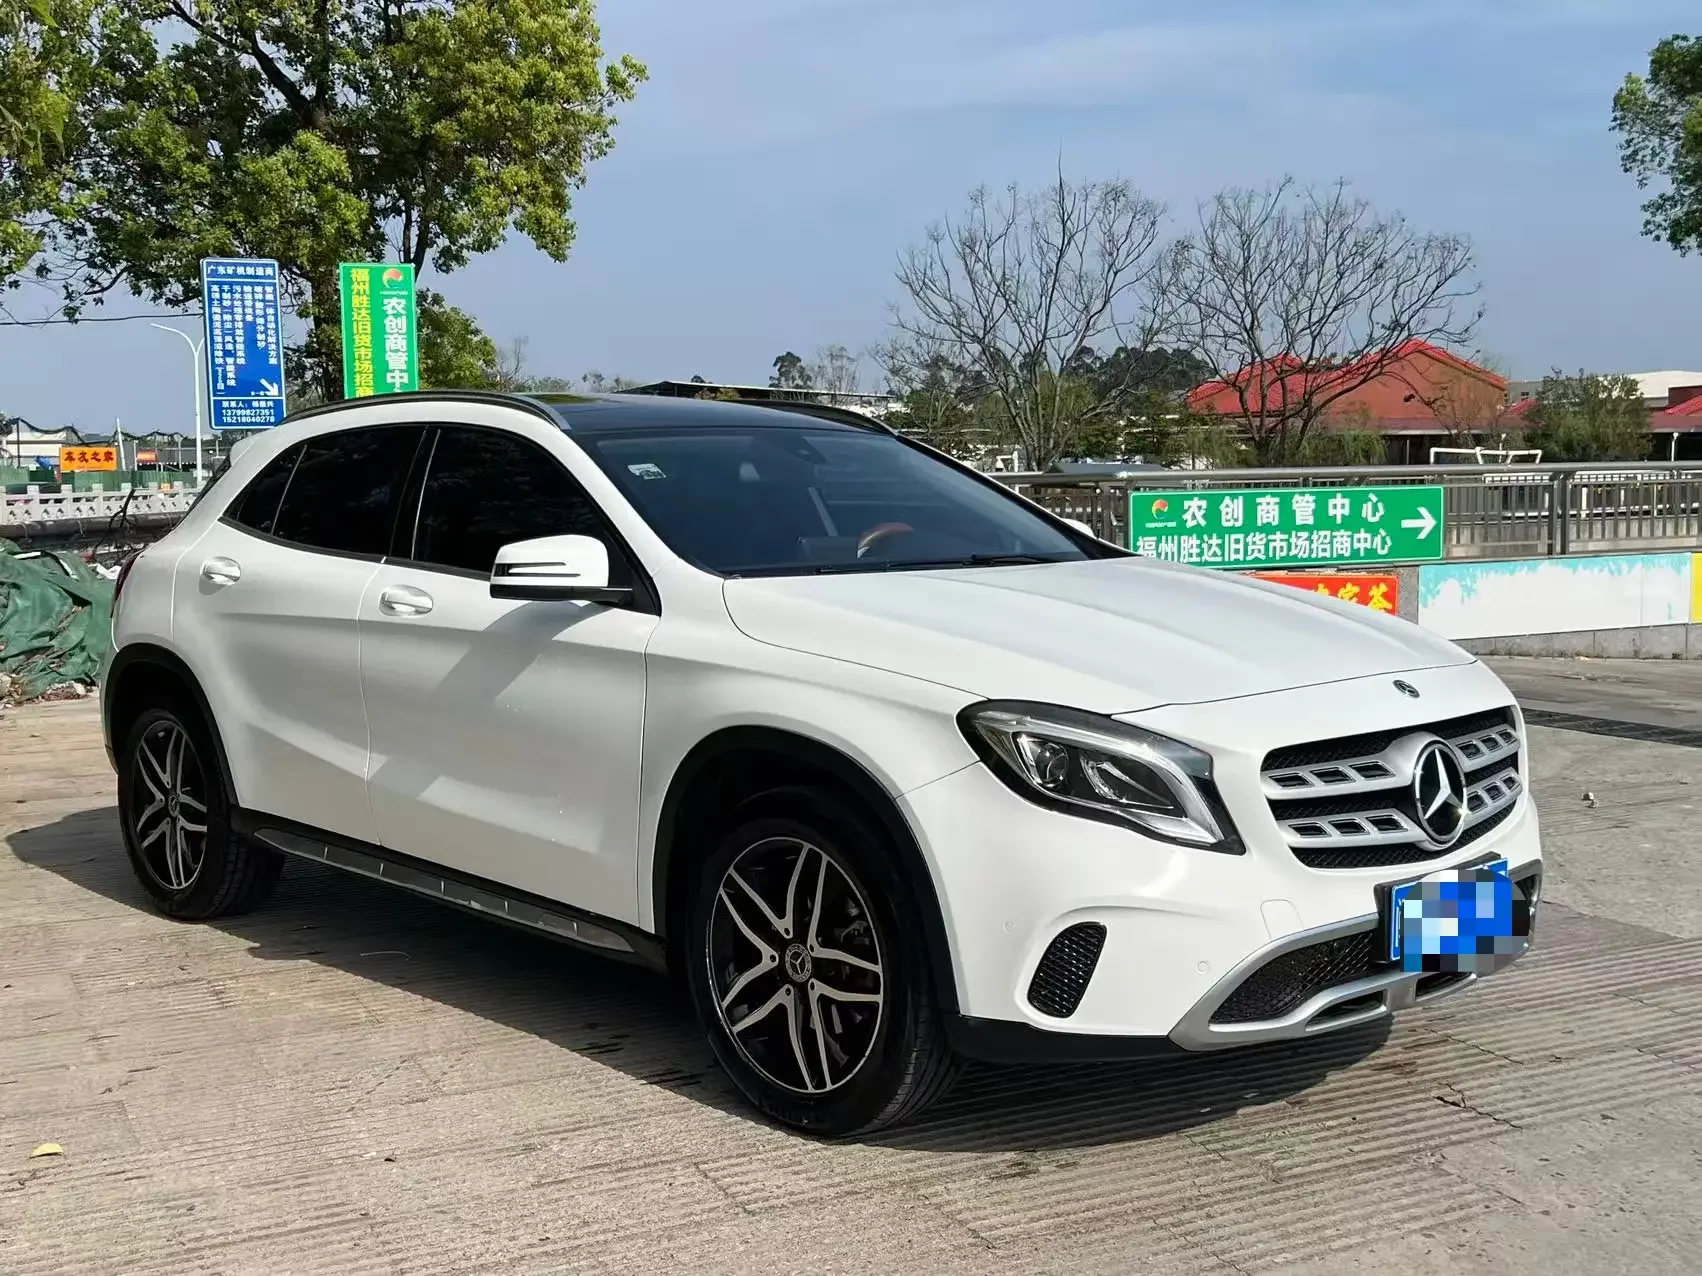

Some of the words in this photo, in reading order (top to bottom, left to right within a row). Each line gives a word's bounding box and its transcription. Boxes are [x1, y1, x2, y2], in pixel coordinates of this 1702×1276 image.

[207, 265, 274, 276] 广东矿机制造商
[382, 297, 409, 392] 农创商管中
[1183, 493, 1386, 528] 农创商管中心
[1136, 528, 1392, 563] 福州胜达旧货市场招商中心
